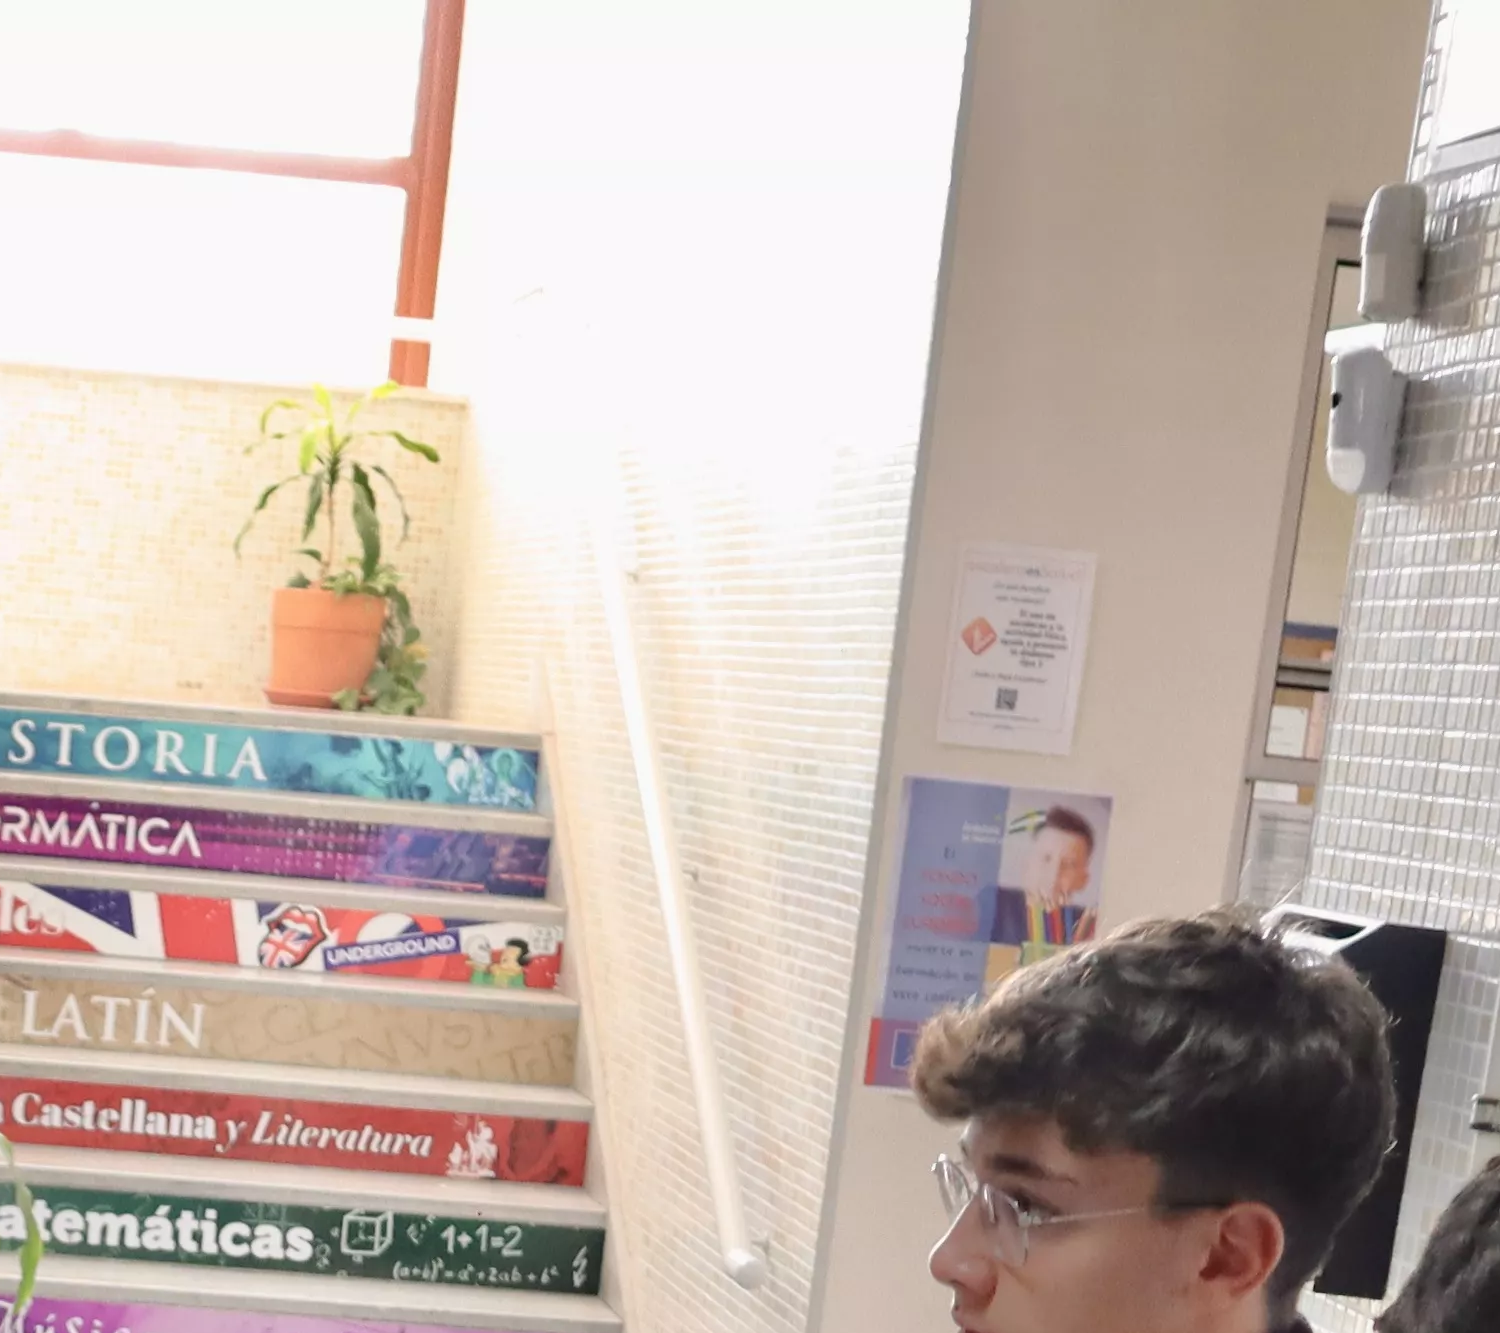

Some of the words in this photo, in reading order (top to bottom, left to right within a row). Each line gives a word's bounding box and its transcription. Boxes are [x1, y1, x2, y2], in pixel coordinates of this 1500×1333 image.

[326, 934, 457, 966] UNDERGROUND
[21, 986, 207, 1049] LATÍN
[11, 1090, 217, 1141] Castellana
[216, 1120, 247, 1152] y
[251, 1110, 434, 1158] Literatura
